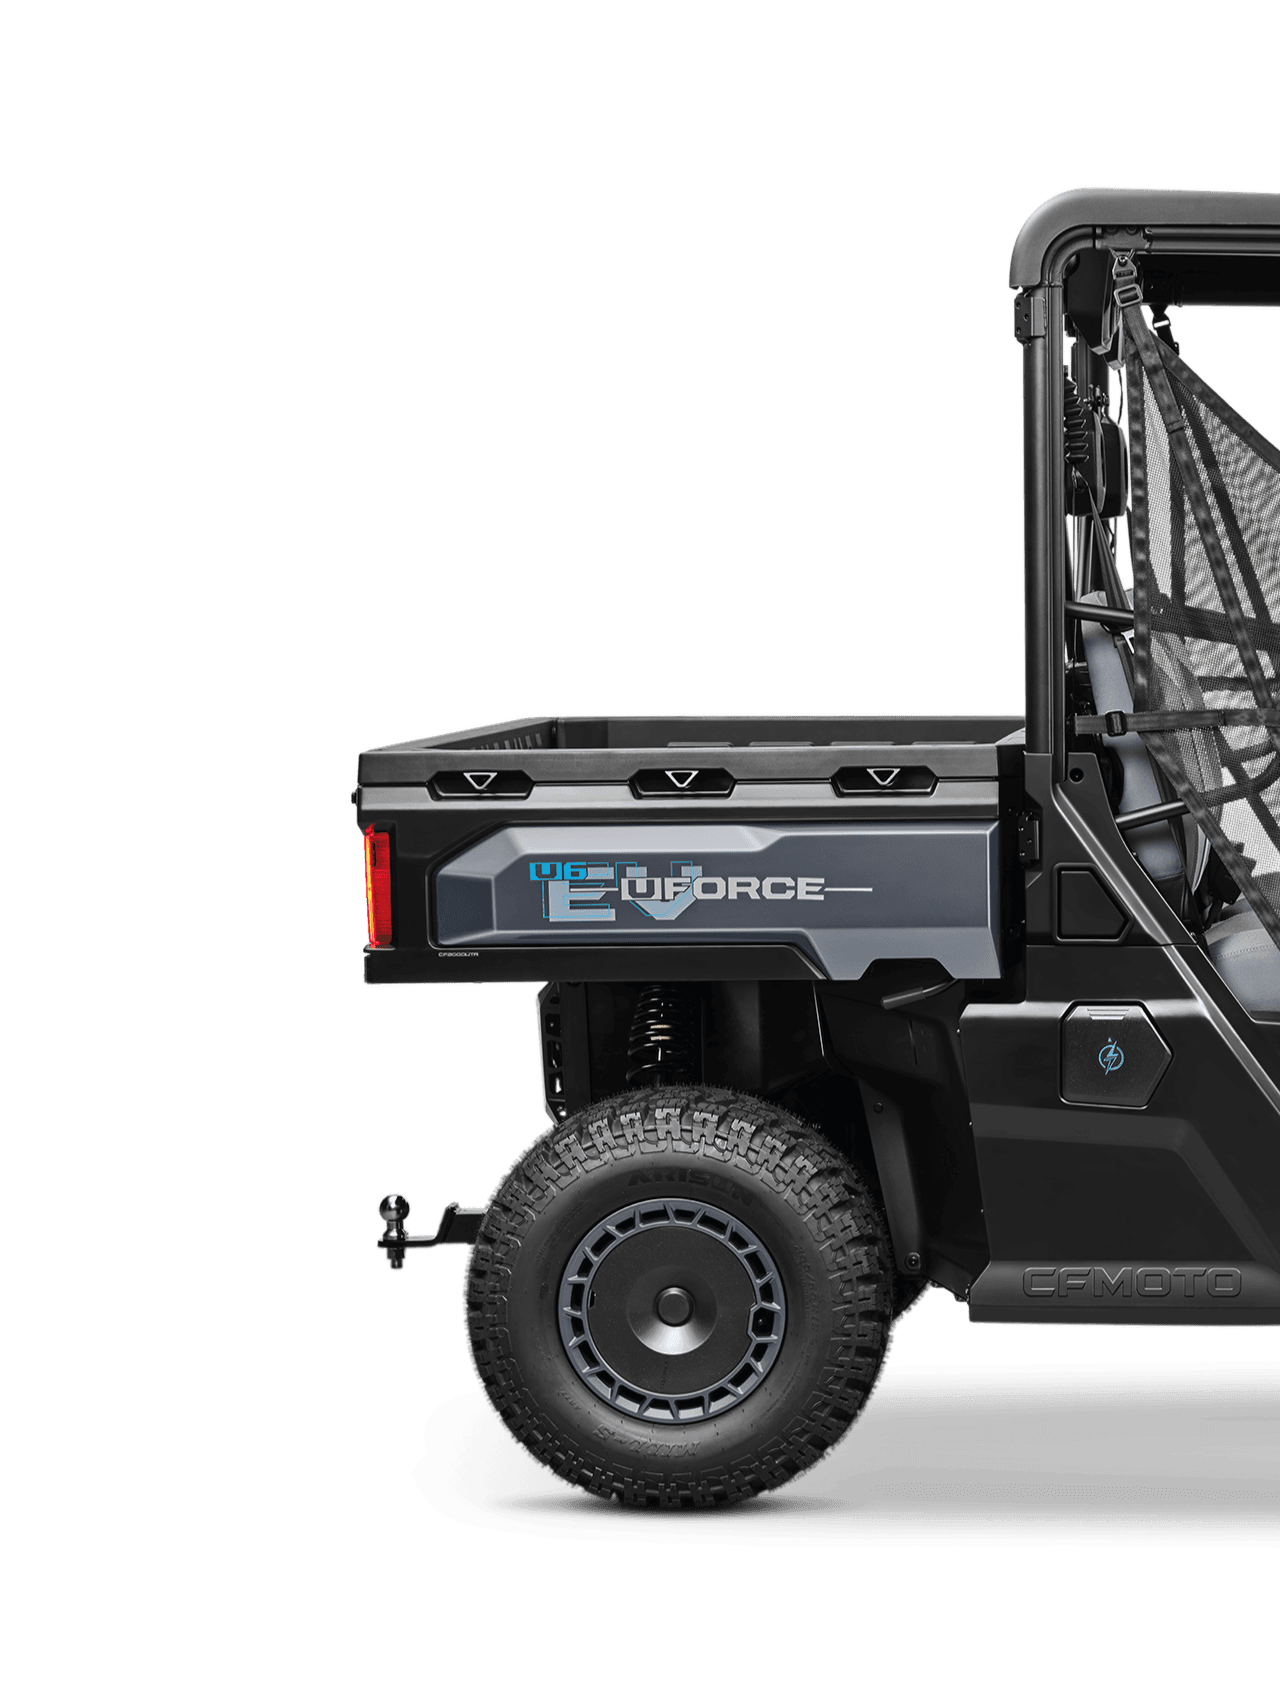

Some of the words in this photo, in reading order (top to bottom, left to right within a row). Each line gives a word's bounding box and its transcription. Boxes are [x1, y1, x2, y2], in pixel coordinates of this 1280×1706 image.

[529, 861, 587, 881] U6
[621, 876, 825, 901] UFORCE
[628, 1168, 755, 1207] ARISUN
[1022, 1267, 1242, 1297] CFMOTO
